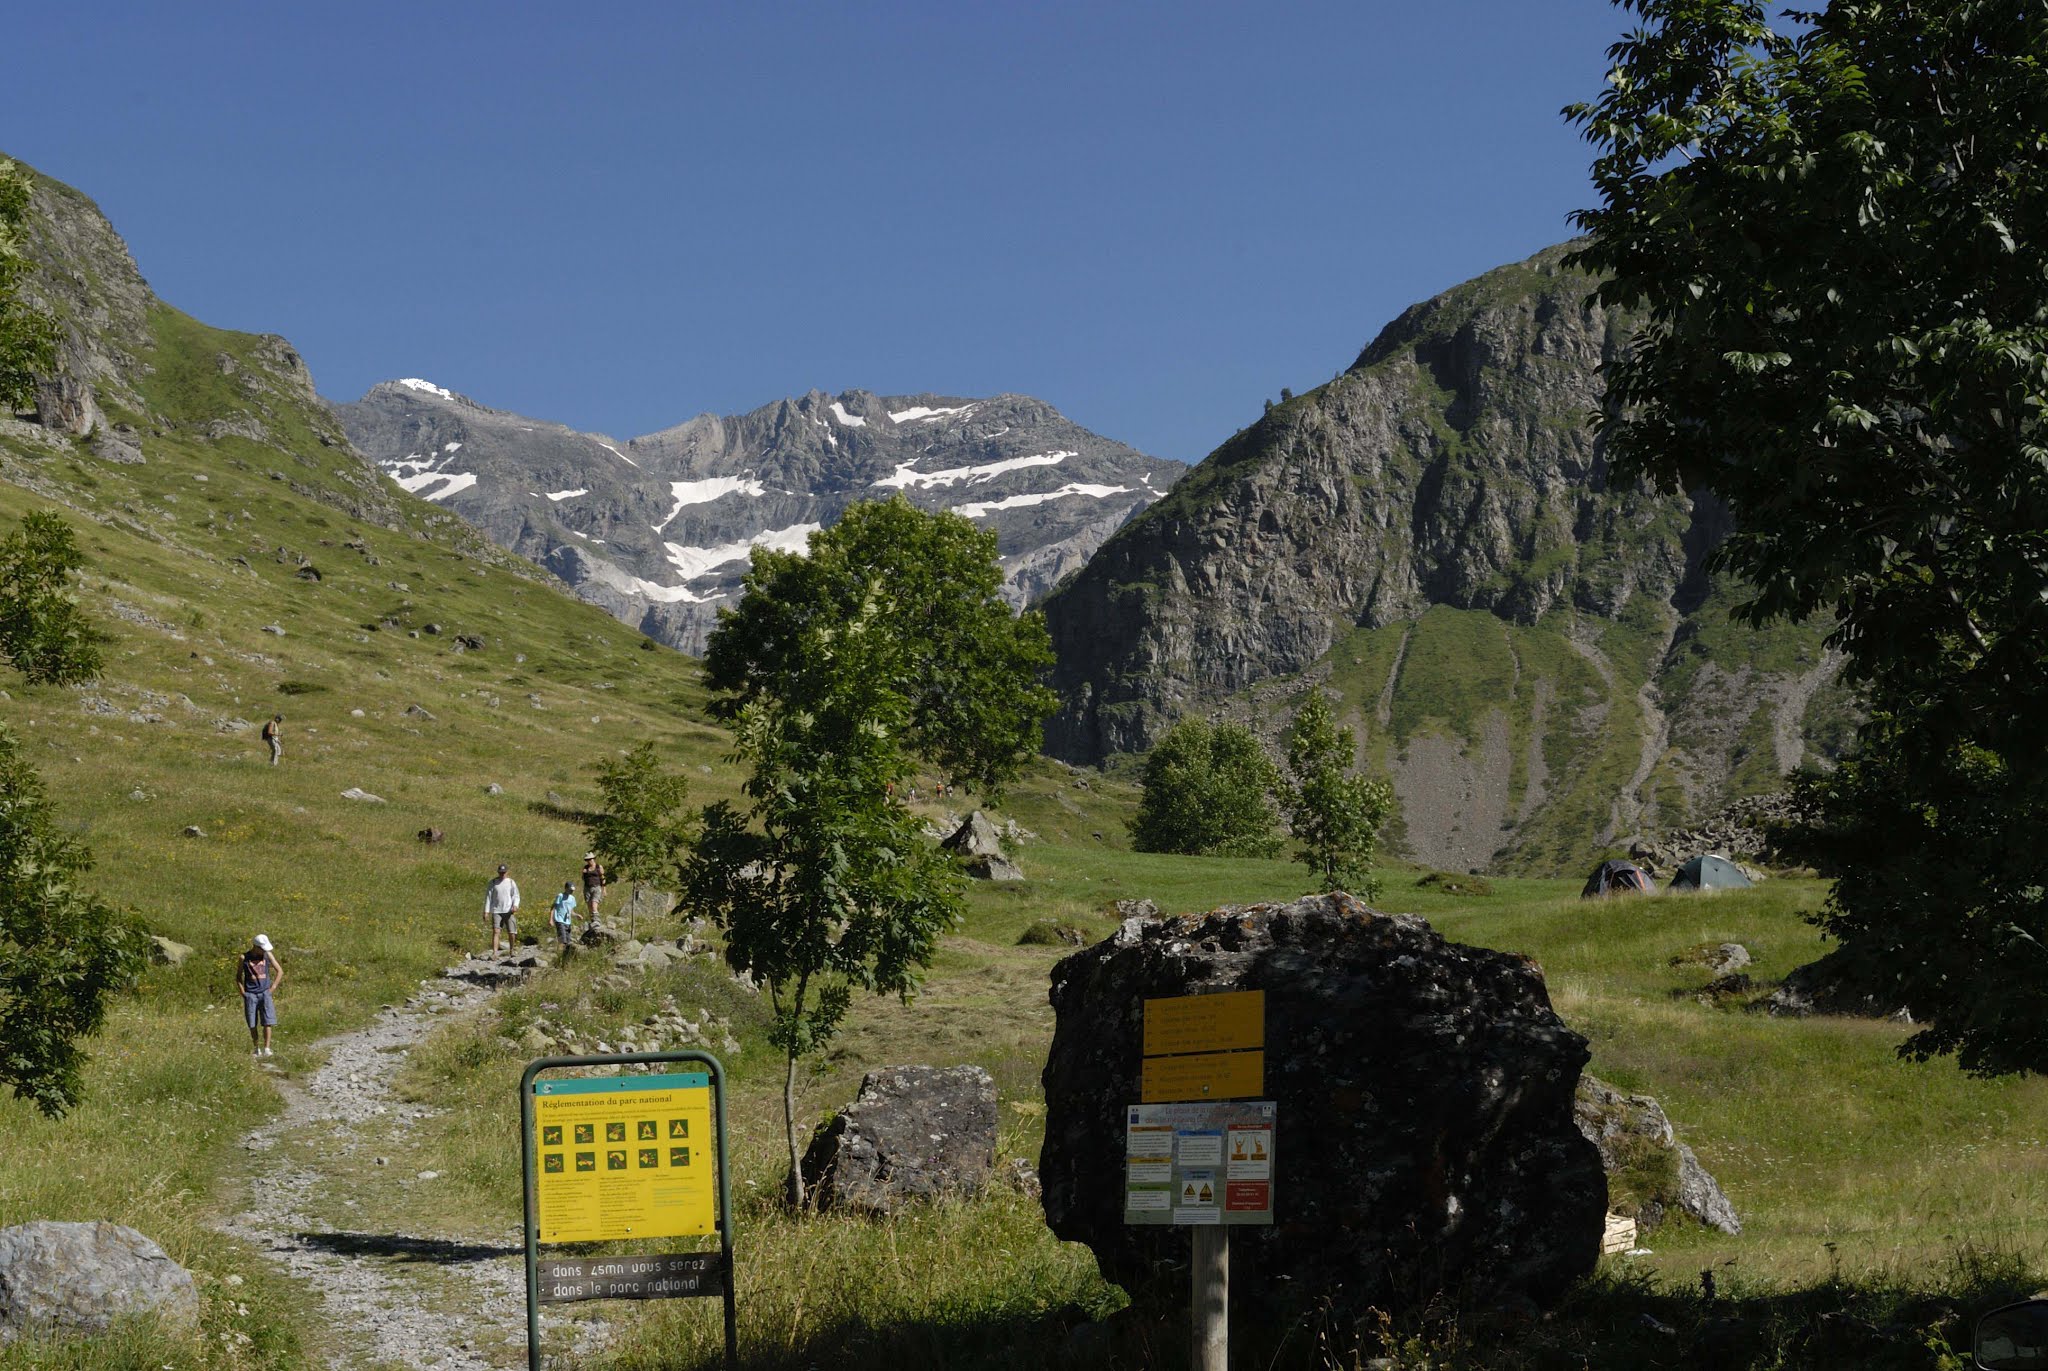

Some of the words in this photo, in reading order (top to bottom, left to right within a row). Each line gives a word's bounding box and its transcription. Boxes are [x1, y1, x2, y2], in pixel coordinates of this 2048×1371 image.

[619, 1098, 637, 1107] parc
[639, 1094, 672, 1104] national
[552, 1264, 582, 1278] dans
[591, 1263, 624, 1277] 45mn
[631, 1260, 662, 1273] vous
[669, 1259, 706, 1271] serez
[553, 1283, 583, 1297] dans
[591, 1281, 601, 1294] le
[610, 1282, 639, 1297] parc
[647, 1275, 700, 1293] national
